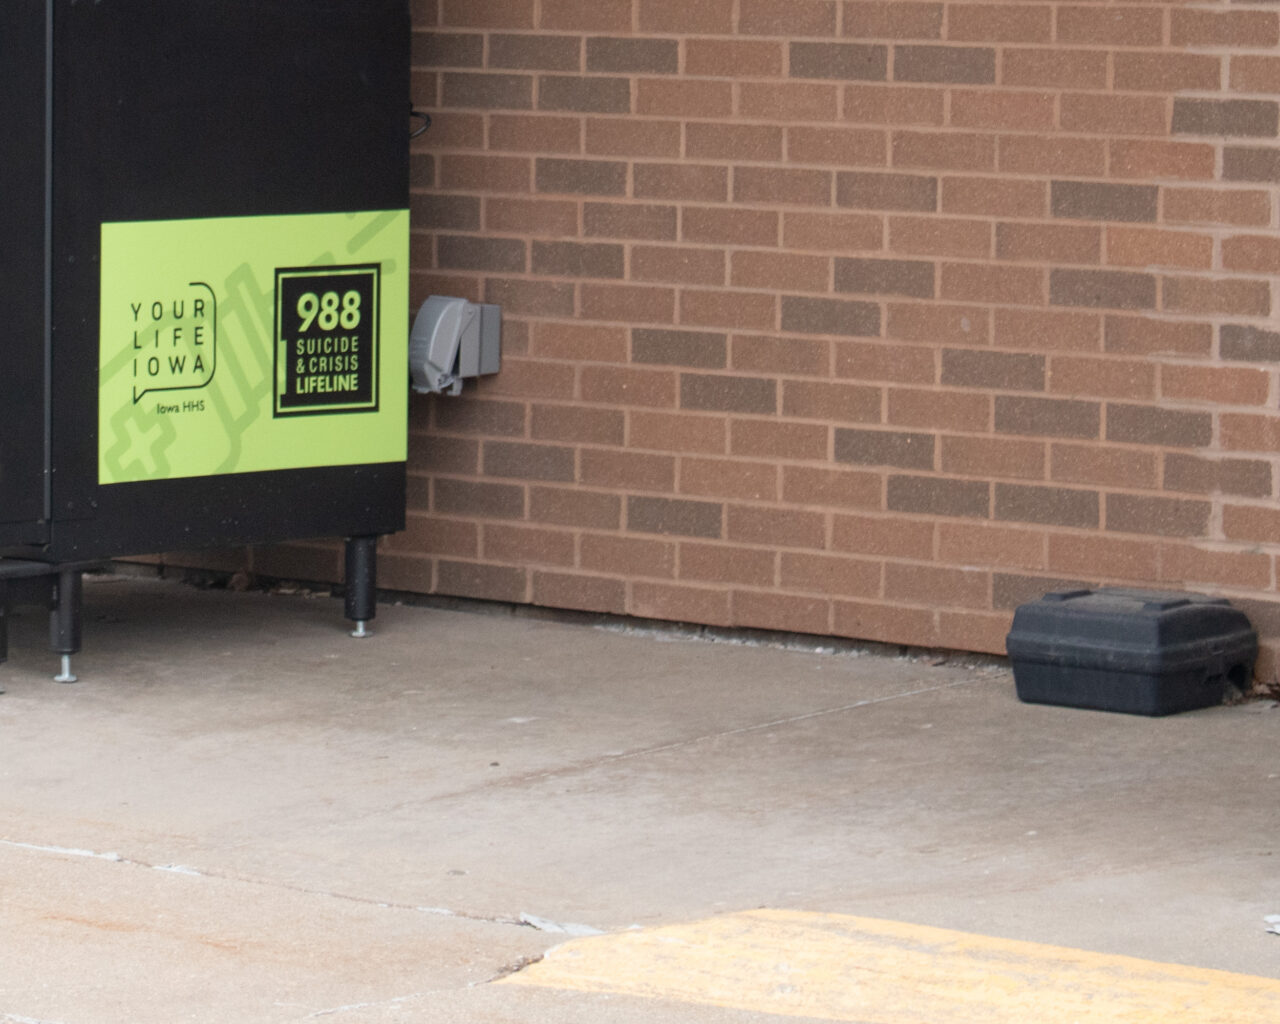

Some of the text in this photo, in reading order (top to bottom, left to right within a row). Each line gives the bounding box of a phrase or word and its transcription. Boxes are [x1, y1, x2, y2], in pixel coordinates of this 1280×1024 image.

[130, 298, 205, 322] YOUR
[297, 289, 361, 332] 988
[133, 326, 204, 349] LIFE
[296, 336, 359, 356] SUICIDE
[133, 354, 205, 377] IOWA
[296, 354, 359, 374] & CRISIS
[296, 374, 359, 394] LIFELINE
[156, 399, 205, 415] Iowa HHS
